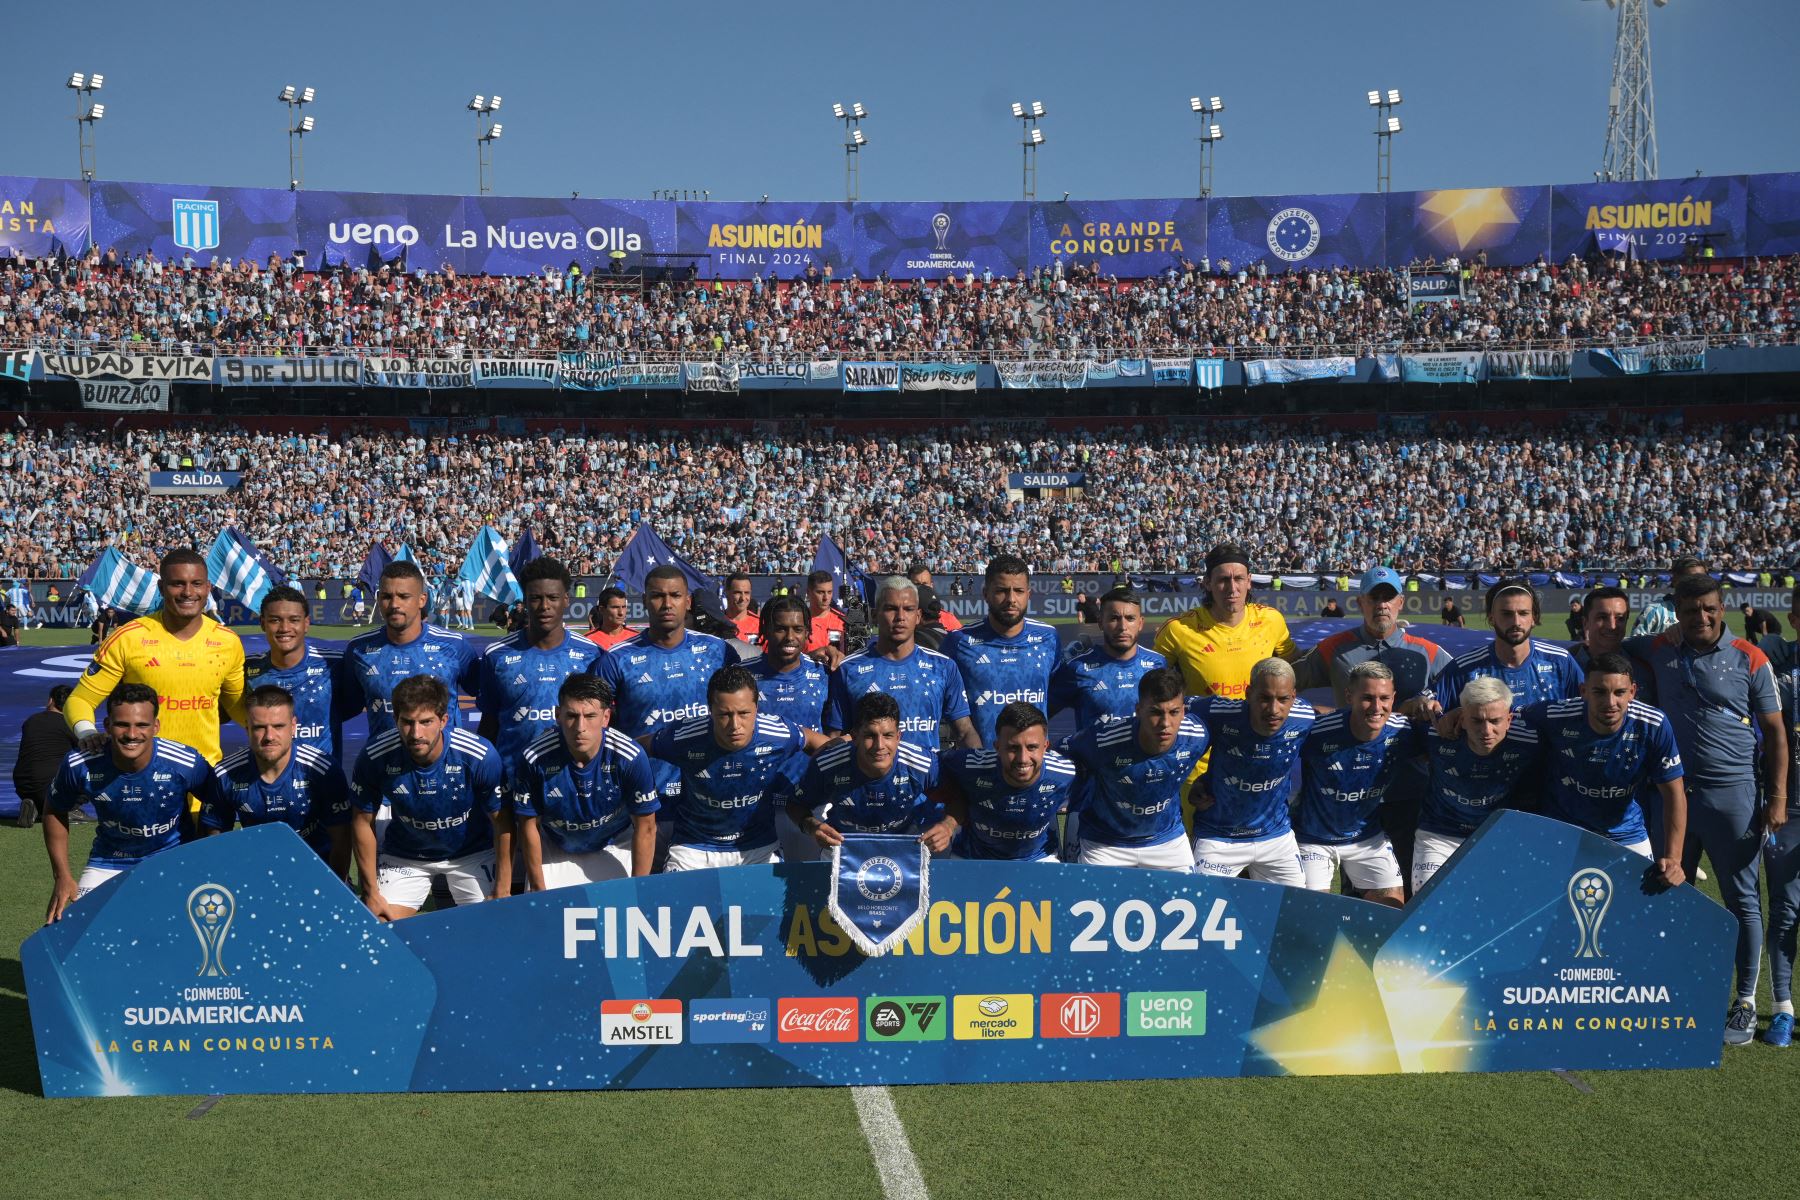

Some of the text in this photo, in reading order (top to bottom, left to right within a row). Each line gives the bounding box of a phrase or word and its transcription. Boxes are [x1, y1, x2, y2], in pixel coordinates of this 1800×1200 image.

[176, 203, 214, 212] RACING
[1585, 195, 1712, 230] ASUNCIÓN
[1272, 208, 1315, 226] CRUZEIRO
[329, 222, 419, 246] ueno
[708, 217, 823, 249] ASUNCIÓN
[1060, 221, 1175, 237] A GRANDE
[445, 224, 642, 253] La Nueva Olla
[1049, 237, 1184, 256] CONQUISTA
[1268, 229, 1318, 259] ESPORTE CLUBE
[720, 252, 812, 265] FINAL 2024
[906, 259, 976, 269] SUDAMERICANA
[1412, 279, 1457, 292] SALIDA
[44, 354, 211, 377] CIUDAD EVITA
[226, 359, 358, 383] 9 DE JULIO
[365, 359, 472, 374] A LO RACING
[481, 361, 555, 380] CABALLITO
[739, 362, 806, 377] PACHECO
[387, 373, 418, 386] VIVE
[84, 383, 161, 405] BURZACO
[172, 473, 223, 486] SALIDA
[1023, 475, 1069, 486] SALIDA
[993, 688, 1045, 705] betfair
[293, 723, 325, 739] fair
[118, 814, 180, 838] betfair
[412, 808, 472, 831] betfair
[862, 858, 898, 872] CRUZEIRO
[886, 876, 901, 898] CLUBE
[563, 906, 763, 959] FINAL
[1069, 897, 1243, 952] 2024
[1560, 968, 1616, 981] CONMEBOL
[184, 987, 245, 1001] CONMEBOL
[1502, 985, 1671, 1005] SUDAMERICANA
[1140, 997, 1193, 1012] ueno
[124, 1004, 304, 1026] SUDAMERICANA
[692, 1010, 767, 1023] sportingbet
[877, 1008, 900, 1021] EA
[1064, 1000, 1098, 1032] MG
[1140, 1012, 1193, 1030] bank
[875, 1020, 900, 1029] SPORTS
[969, 1018, 1017, 1029] mercado
[1473, 1016, 1697, 1032] LA GRAN CONQUISTA
[610, 1025, 673, 1041] AMSTEL
[981, 1028, 1005, 1038] libre
[131, 1038, 192, 1054] GRAN
[203, 1036, 335, 1053] CONQUISTA
